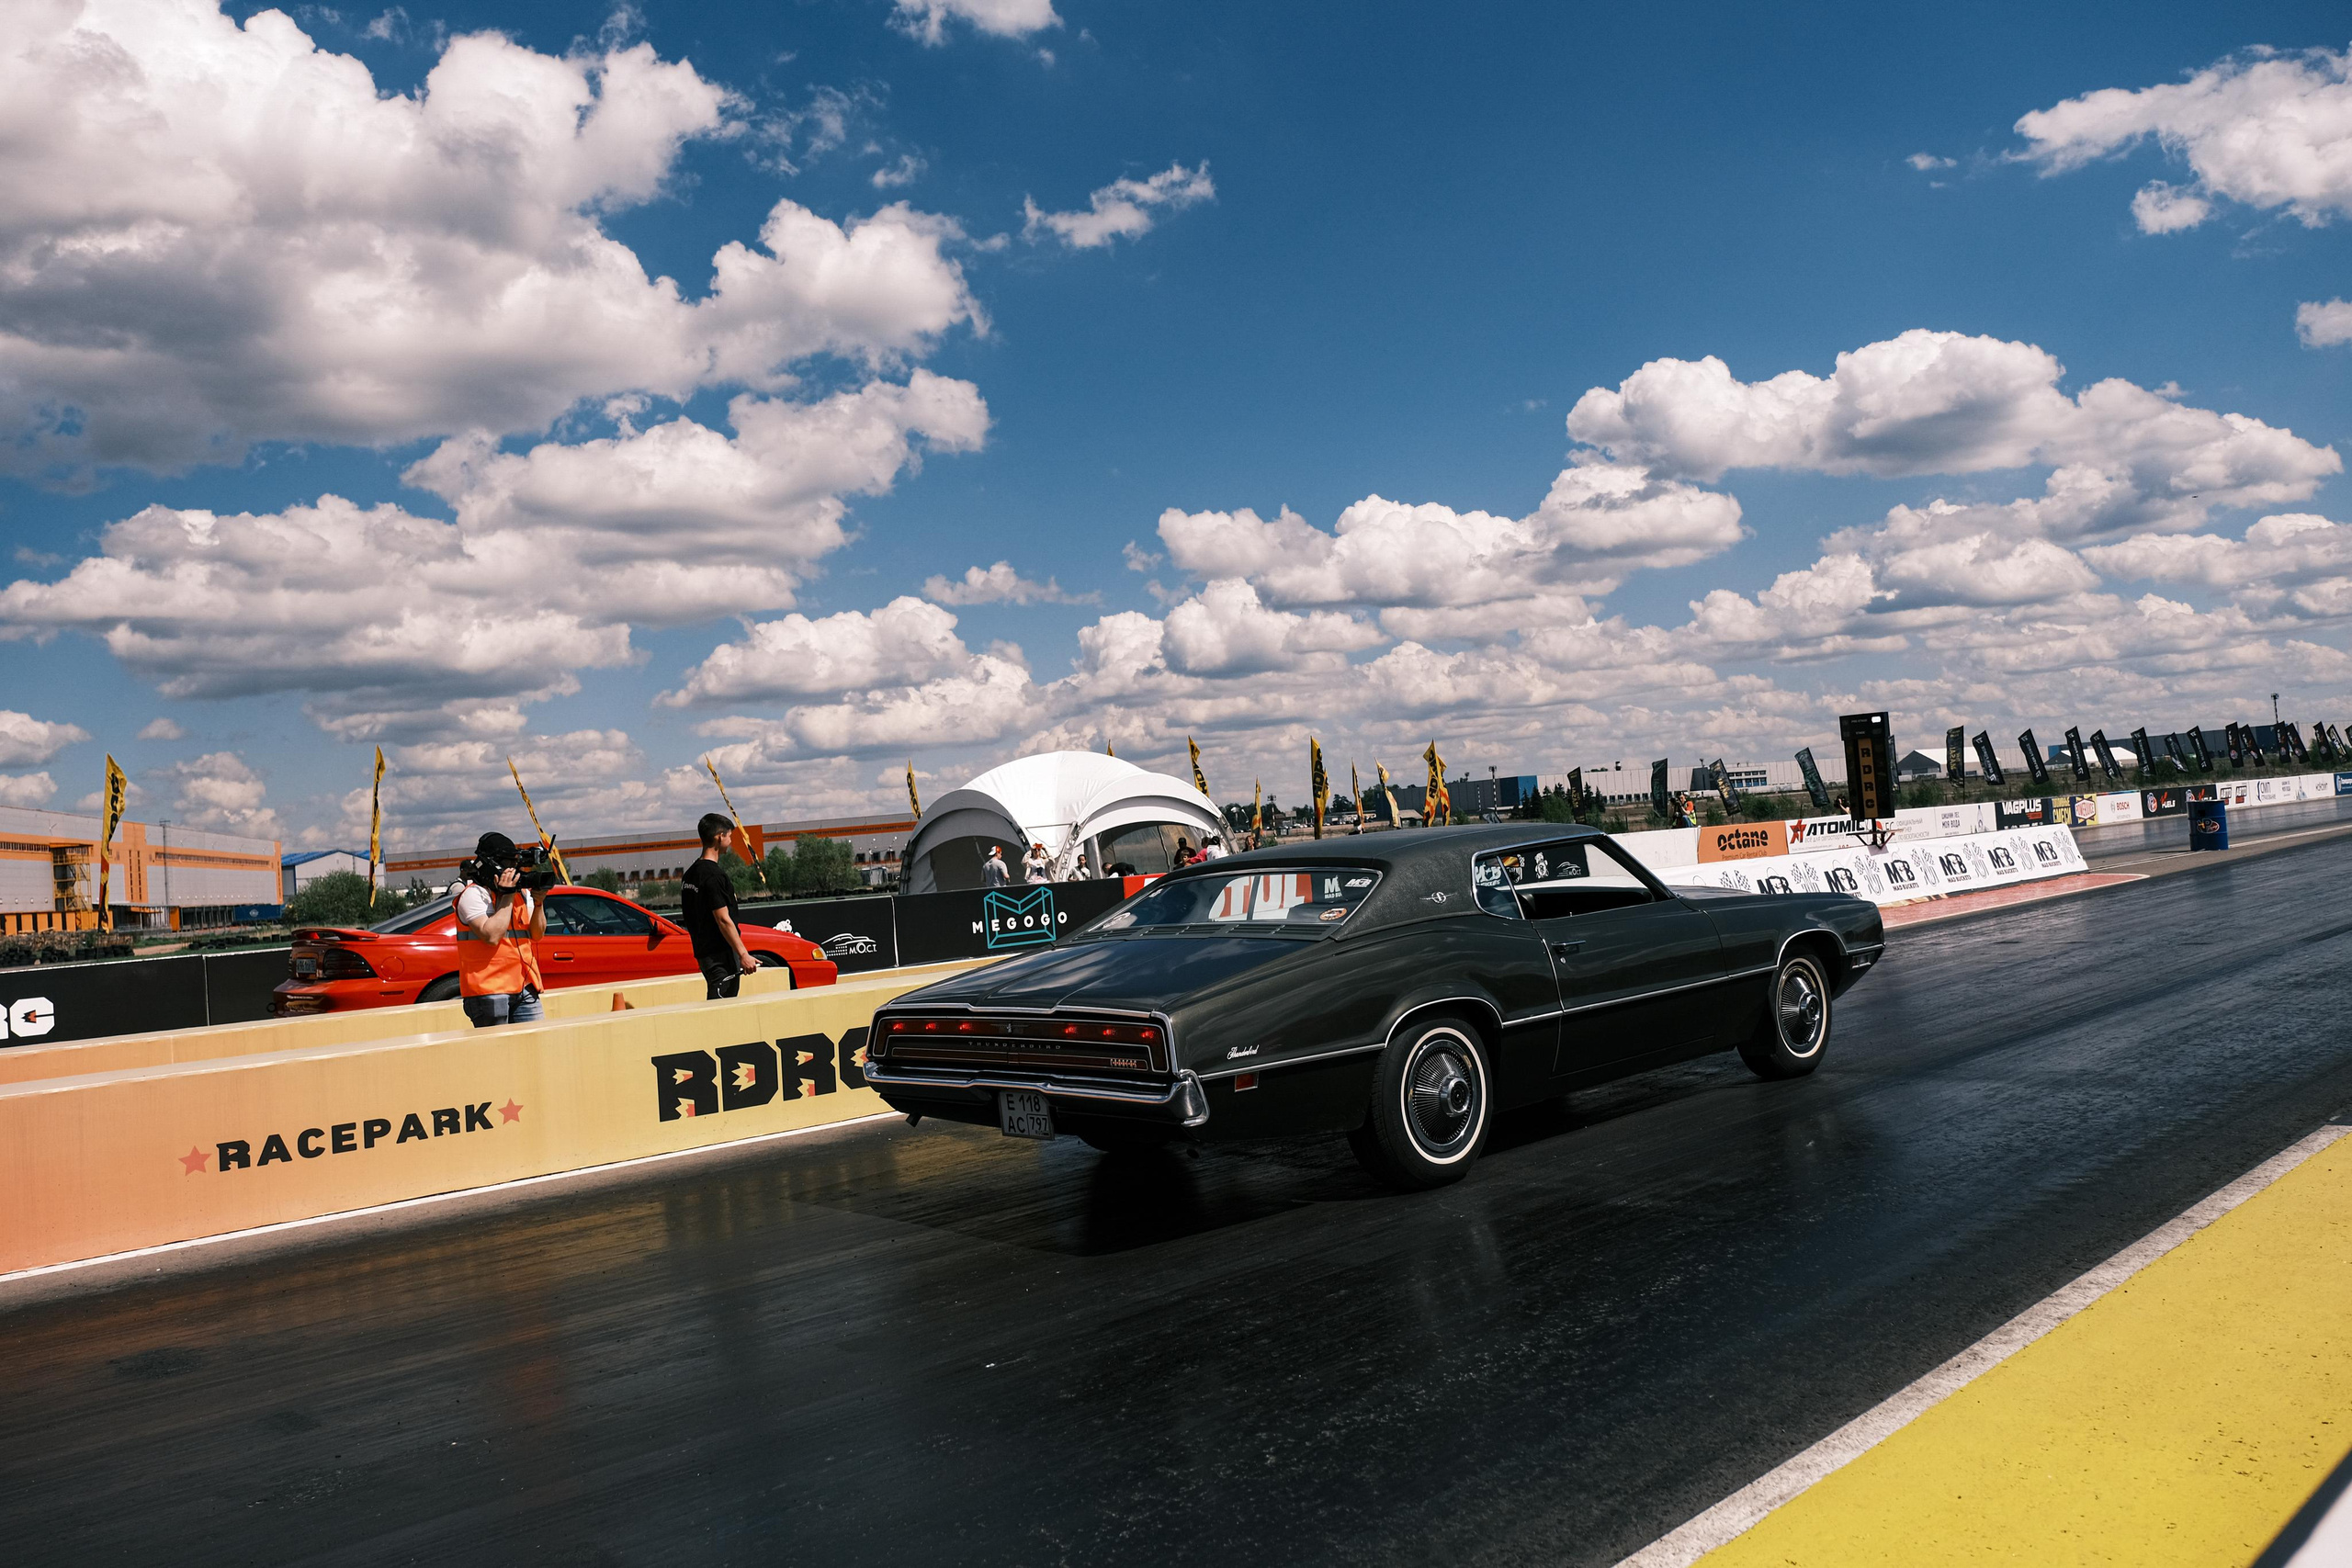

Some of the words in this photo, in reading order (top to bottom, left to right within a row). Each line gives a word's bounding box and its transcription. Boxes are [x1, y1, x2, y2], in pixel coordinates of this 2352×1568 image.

[2001, 798, 2042, 816] VAGPLUS
[2116, 801, 2131, 810] BOSCH
[1717, 829, 1769, 852] octane
[972, 911, 1068, 934] MEGOGO
[968, 1041, 1061, 1050] THUNDERBIRD
[1227, 1043, 1260, 1060] Thunderbird
[1019, 1094, 1041, 1112] 118
[1008, 1115, 1026, 1134] AC
[1029, 1116, 1047, 1132] 797
[216, 1100, 494, 1173] RACEPARK
